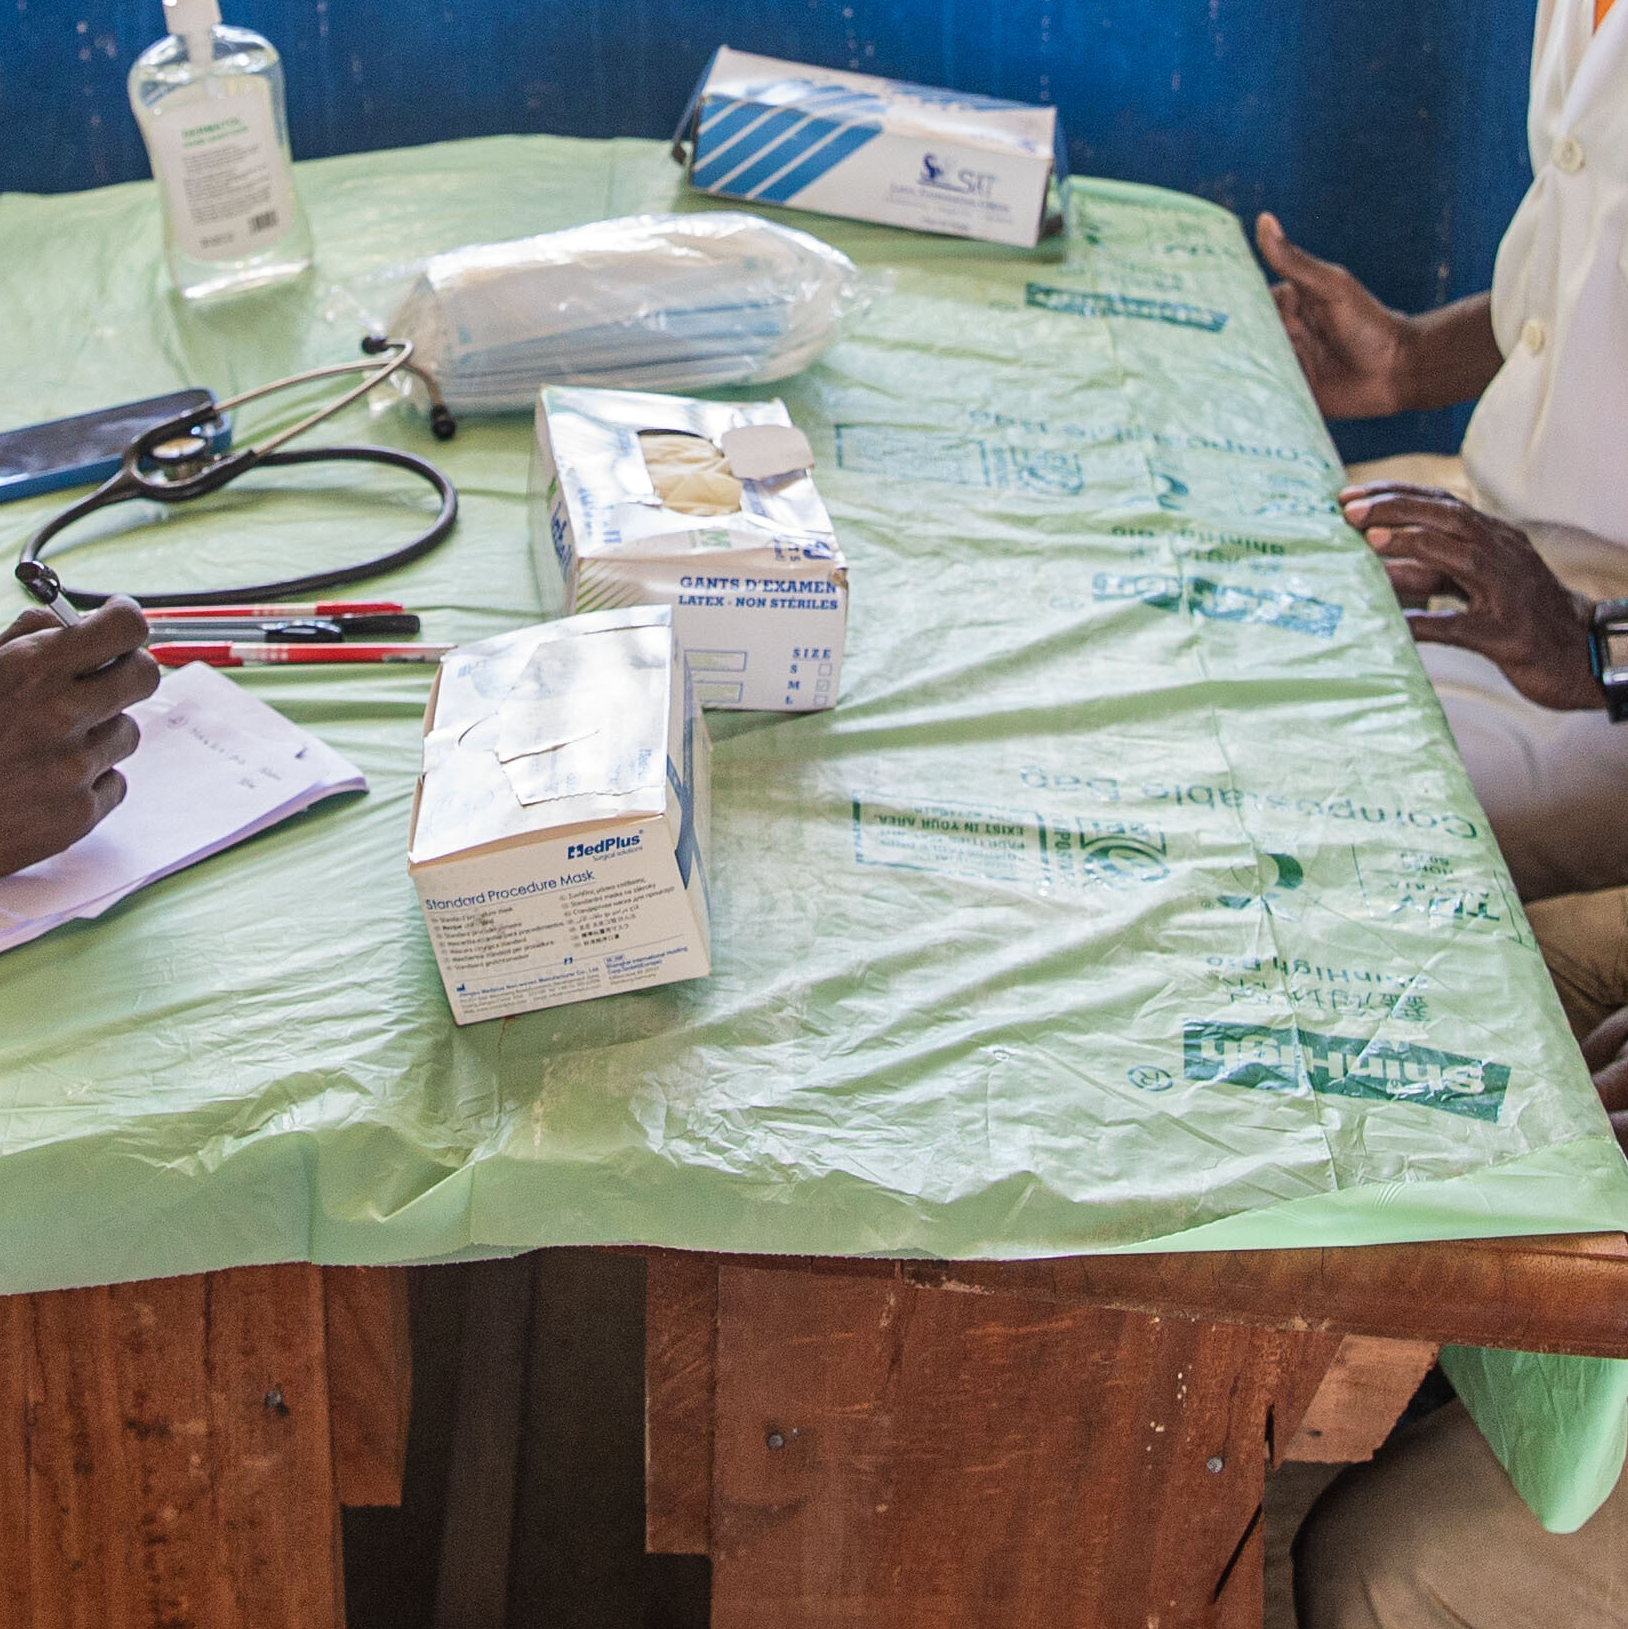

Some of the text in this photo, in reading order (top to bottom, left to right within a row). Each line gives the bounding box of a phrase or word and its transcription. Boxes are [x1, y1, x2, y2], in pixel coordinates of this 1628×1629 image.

[680, 577, 837, 594] GANTS D'EXAMEN
[678, 595, 723, 607] LATEX
[735, 597, 768, 608] NON
[770, 596, 838, 611] STÉRILES
[792, 648, 831, 660] SIZE
[789, 663, 797, 674] S
[787, 680, 800, 690] M
[785, 695, 793, 705] L
[1020, 764, 1478, 840] Compostable Bag
[920, 817, 959, 832] YOUR
[964, 821, 979, 834] IN
[985, 822, 1026, 837] EXIST
[425, 893, 486, 911] Standard
[487, 878, 558, 902] Procedure
[559, 869, 596, 886] Mask
[1197, 1028, 1487, 1099] ShinHigh
